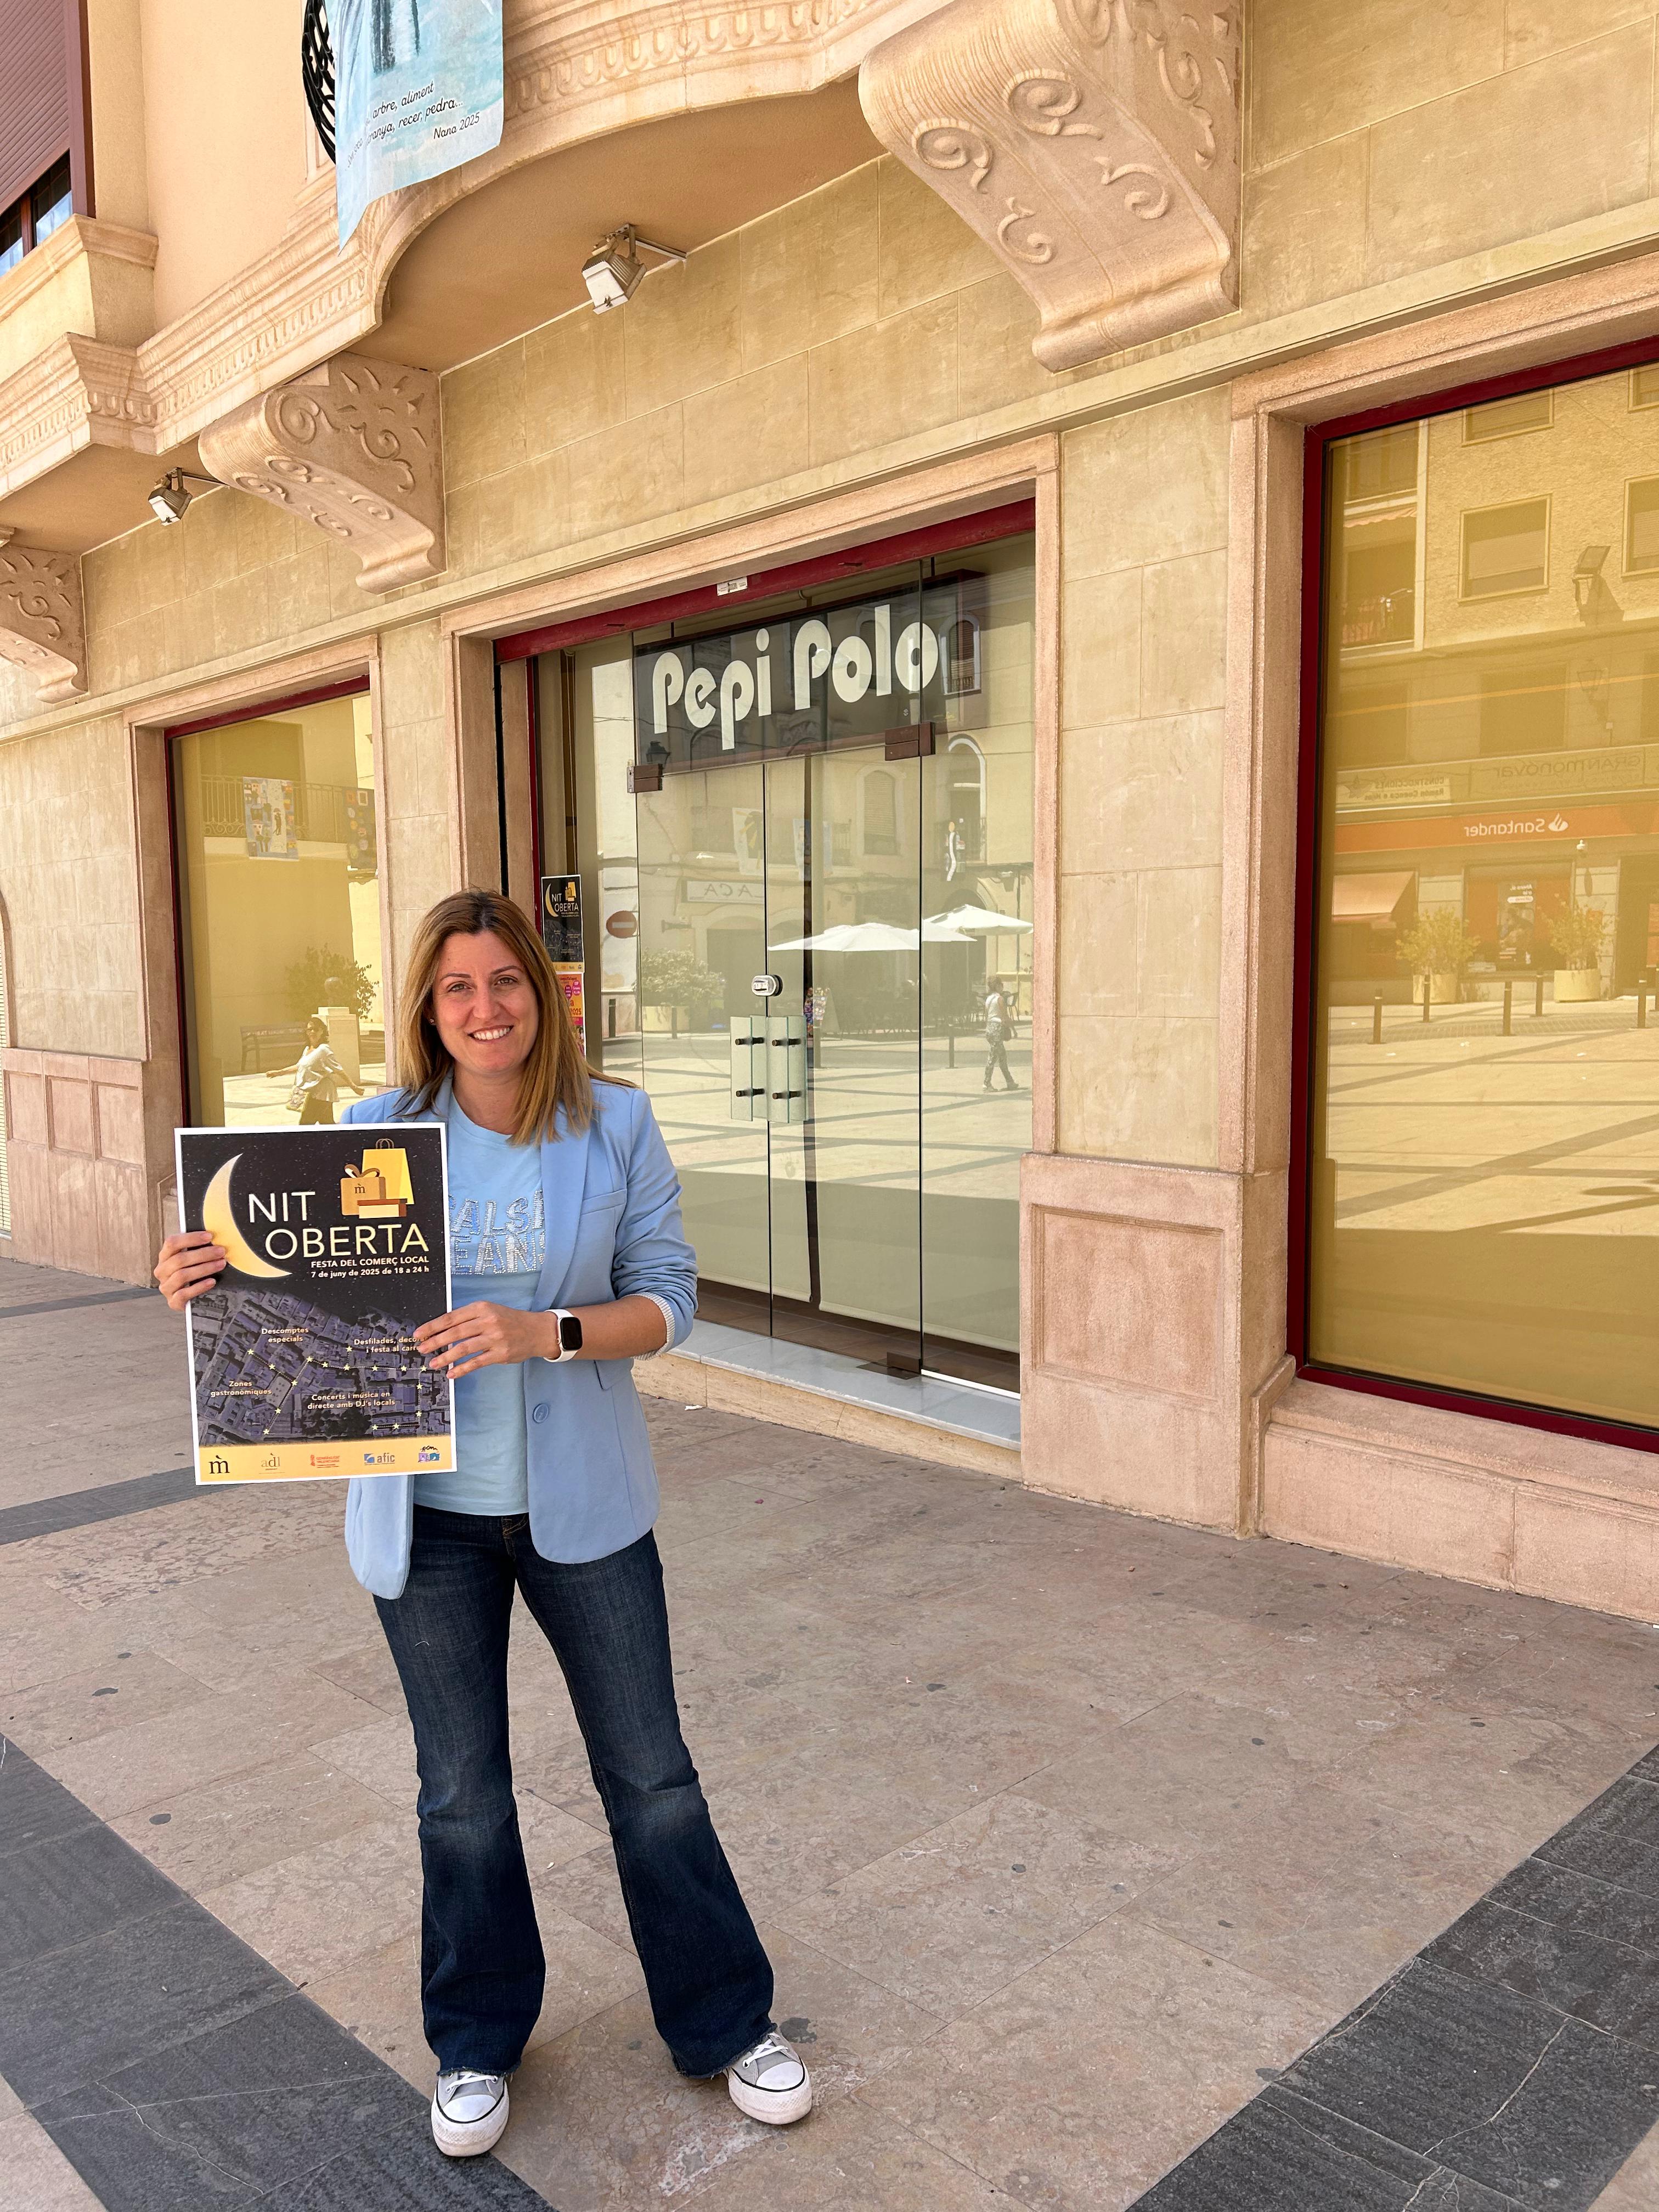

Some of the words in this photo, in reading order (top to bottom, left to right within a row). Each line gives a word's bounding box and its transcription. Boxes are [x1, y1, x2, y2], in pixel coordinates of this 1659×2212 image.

[373, 101, 398, 119] arbre,
[401, 81, 435, 106] aliment
[433, 127, 457, 139] Nana
[459, 111, 481, 130] 2025
[652, 628, 772, 751] Pepi
[794, 604, 938, 710] Polo
[551, 893, 562, 902] NIT
[554, 902, 579, 912] OBERTA
[249, 1191, 316, 1223] NIT
[265, 1223, 430, 1260] OBERTA
[311, 1260, 338, 1268] FESTA
[359, 1257, 398, 1266] COMERÇ
[400, 1256, 430, 1264] LOCAL
[330, 1270, 346, 1279] juny
[268, 1335, 303, 1344] especials
[210, 1389, 273, 1398] gastronòmiques
[377, 1452, 396, 1463] afic
